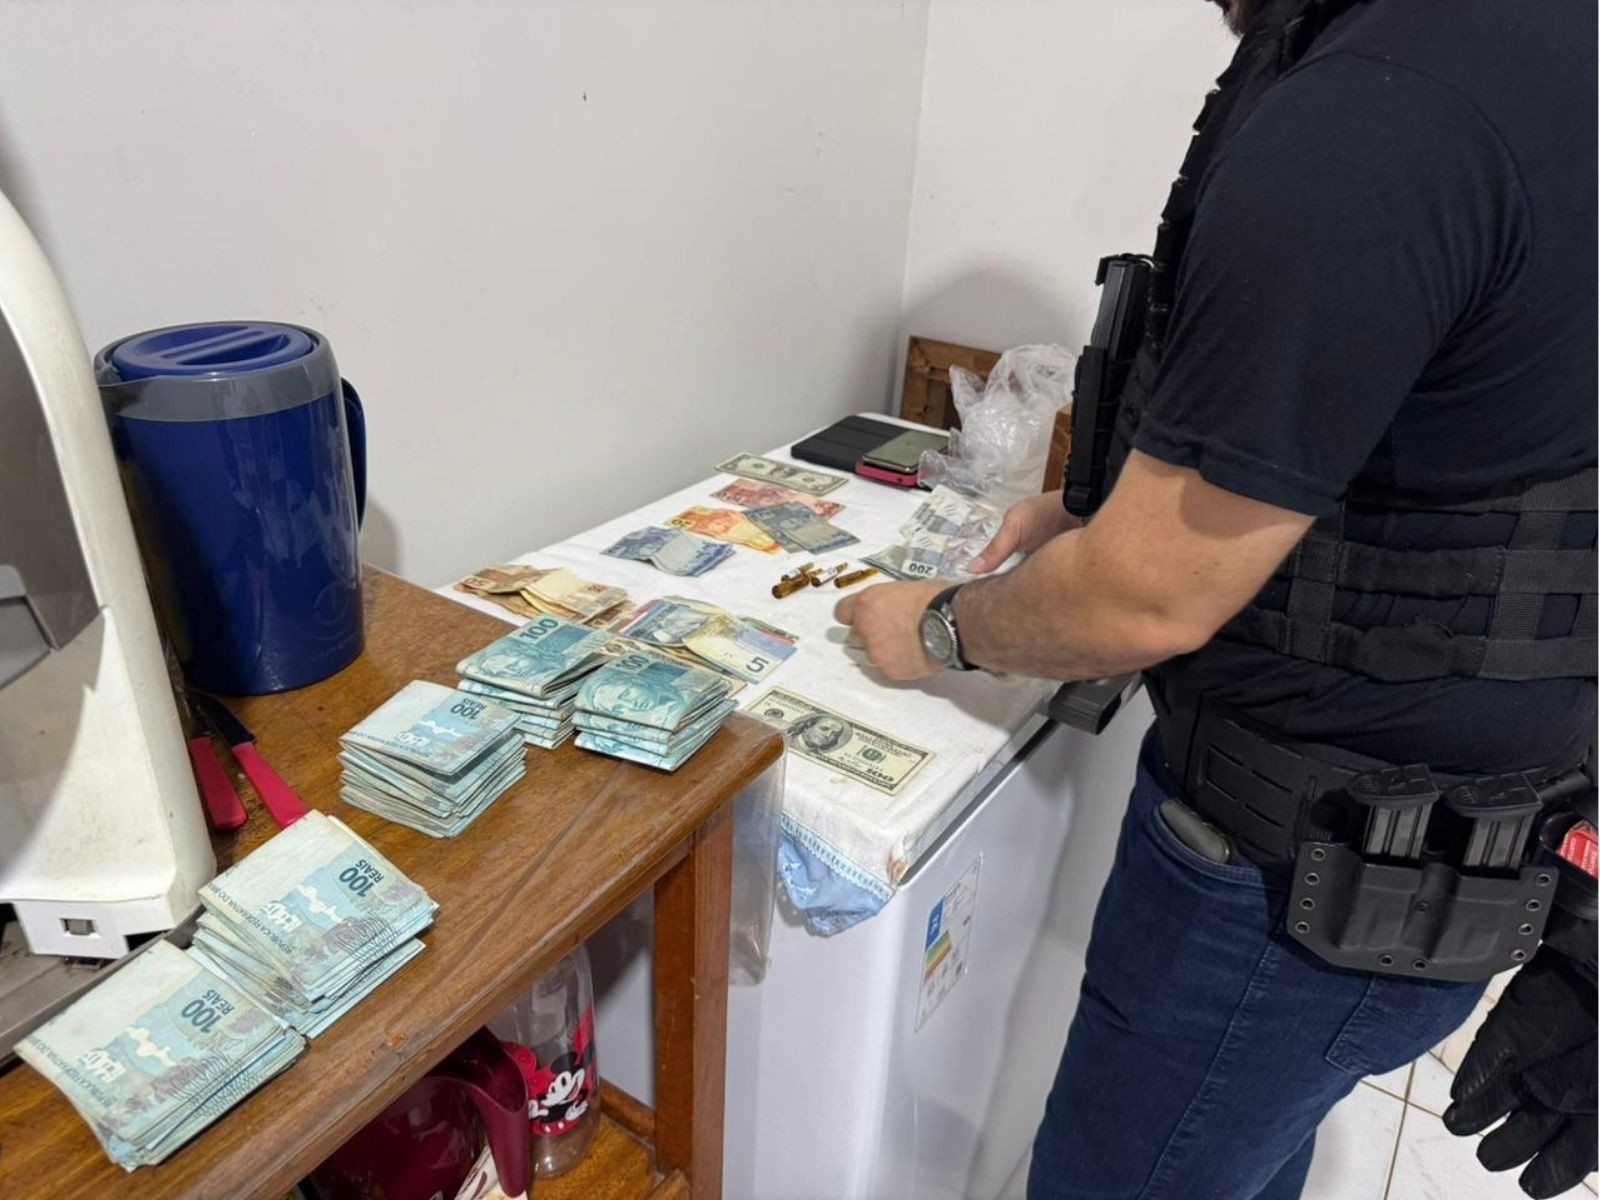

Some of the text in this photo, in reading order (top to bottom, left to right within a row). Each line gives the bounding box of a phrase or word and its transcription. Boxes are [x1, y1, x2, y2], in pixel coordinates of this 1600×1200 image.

[909, 563, 934, 576] 200
[520, 618, 560, 640] 100
[616, 654, 650, 669] 100
[746, 656, 769, 673] 5
[449, 703, 481, 720] 100
[339, 866, 375, 898] 100
[355, 859, 385, 883] REAIS
[202, 988, 235, 1016] REAIS
[180, 999, 222, 1034] 100
